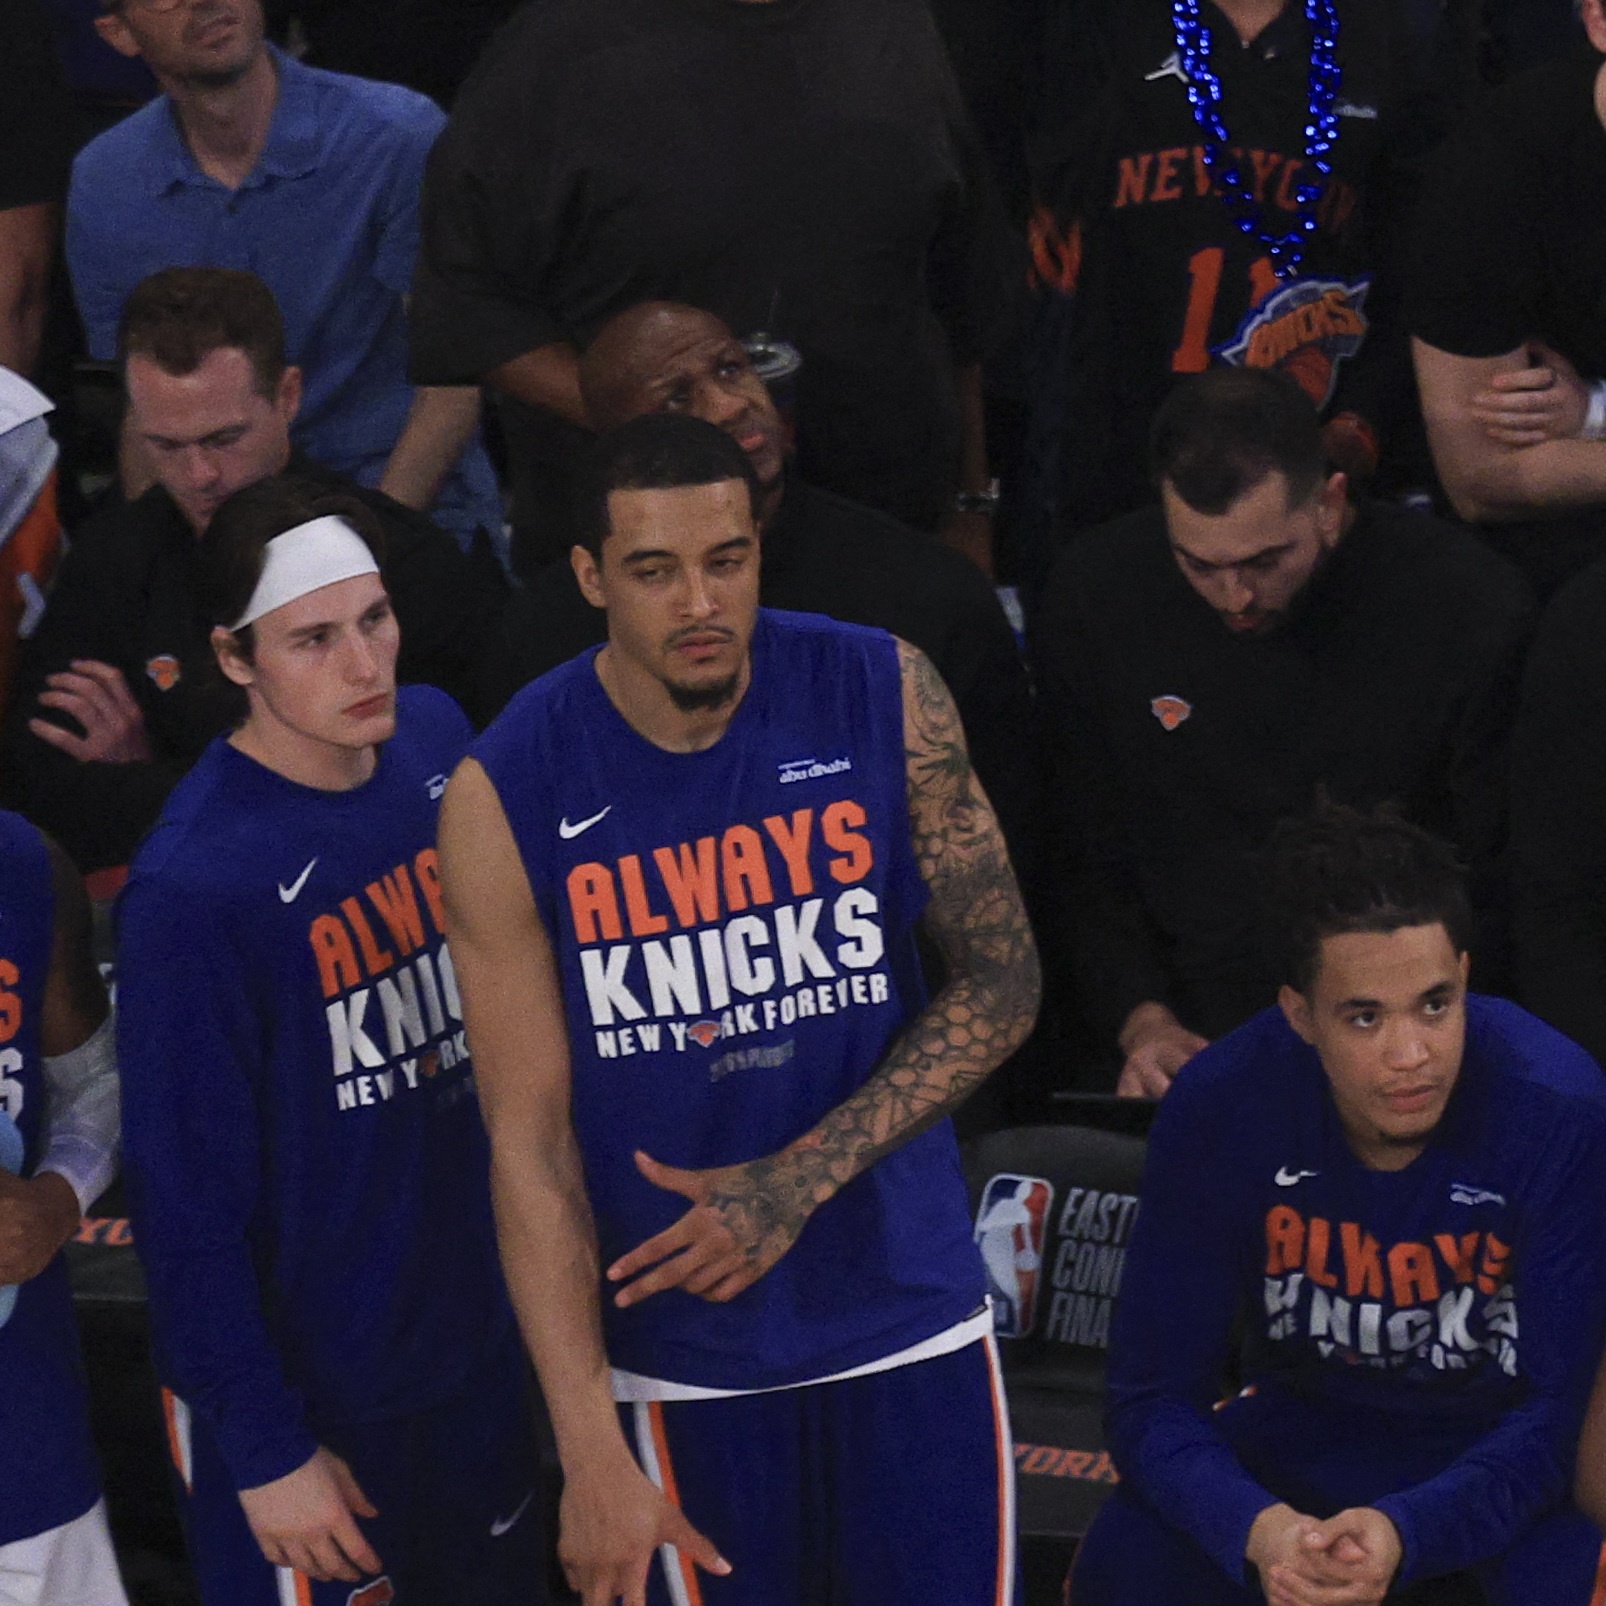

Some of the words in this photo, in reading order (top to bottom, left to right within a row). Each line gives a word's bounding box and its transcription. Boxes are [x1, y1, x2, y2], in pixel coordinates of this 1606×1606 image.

[567, 800, 873, 944] ALWAYS
[579, 887, 884, 1026] KNICKS
[595, 1024, 661, 1059] NEW
[762, 973, 888, 1031] FOREVER
[336, 1070, 394, 1111] NEW
[1058, 1186, 1139, 1244] EAST
